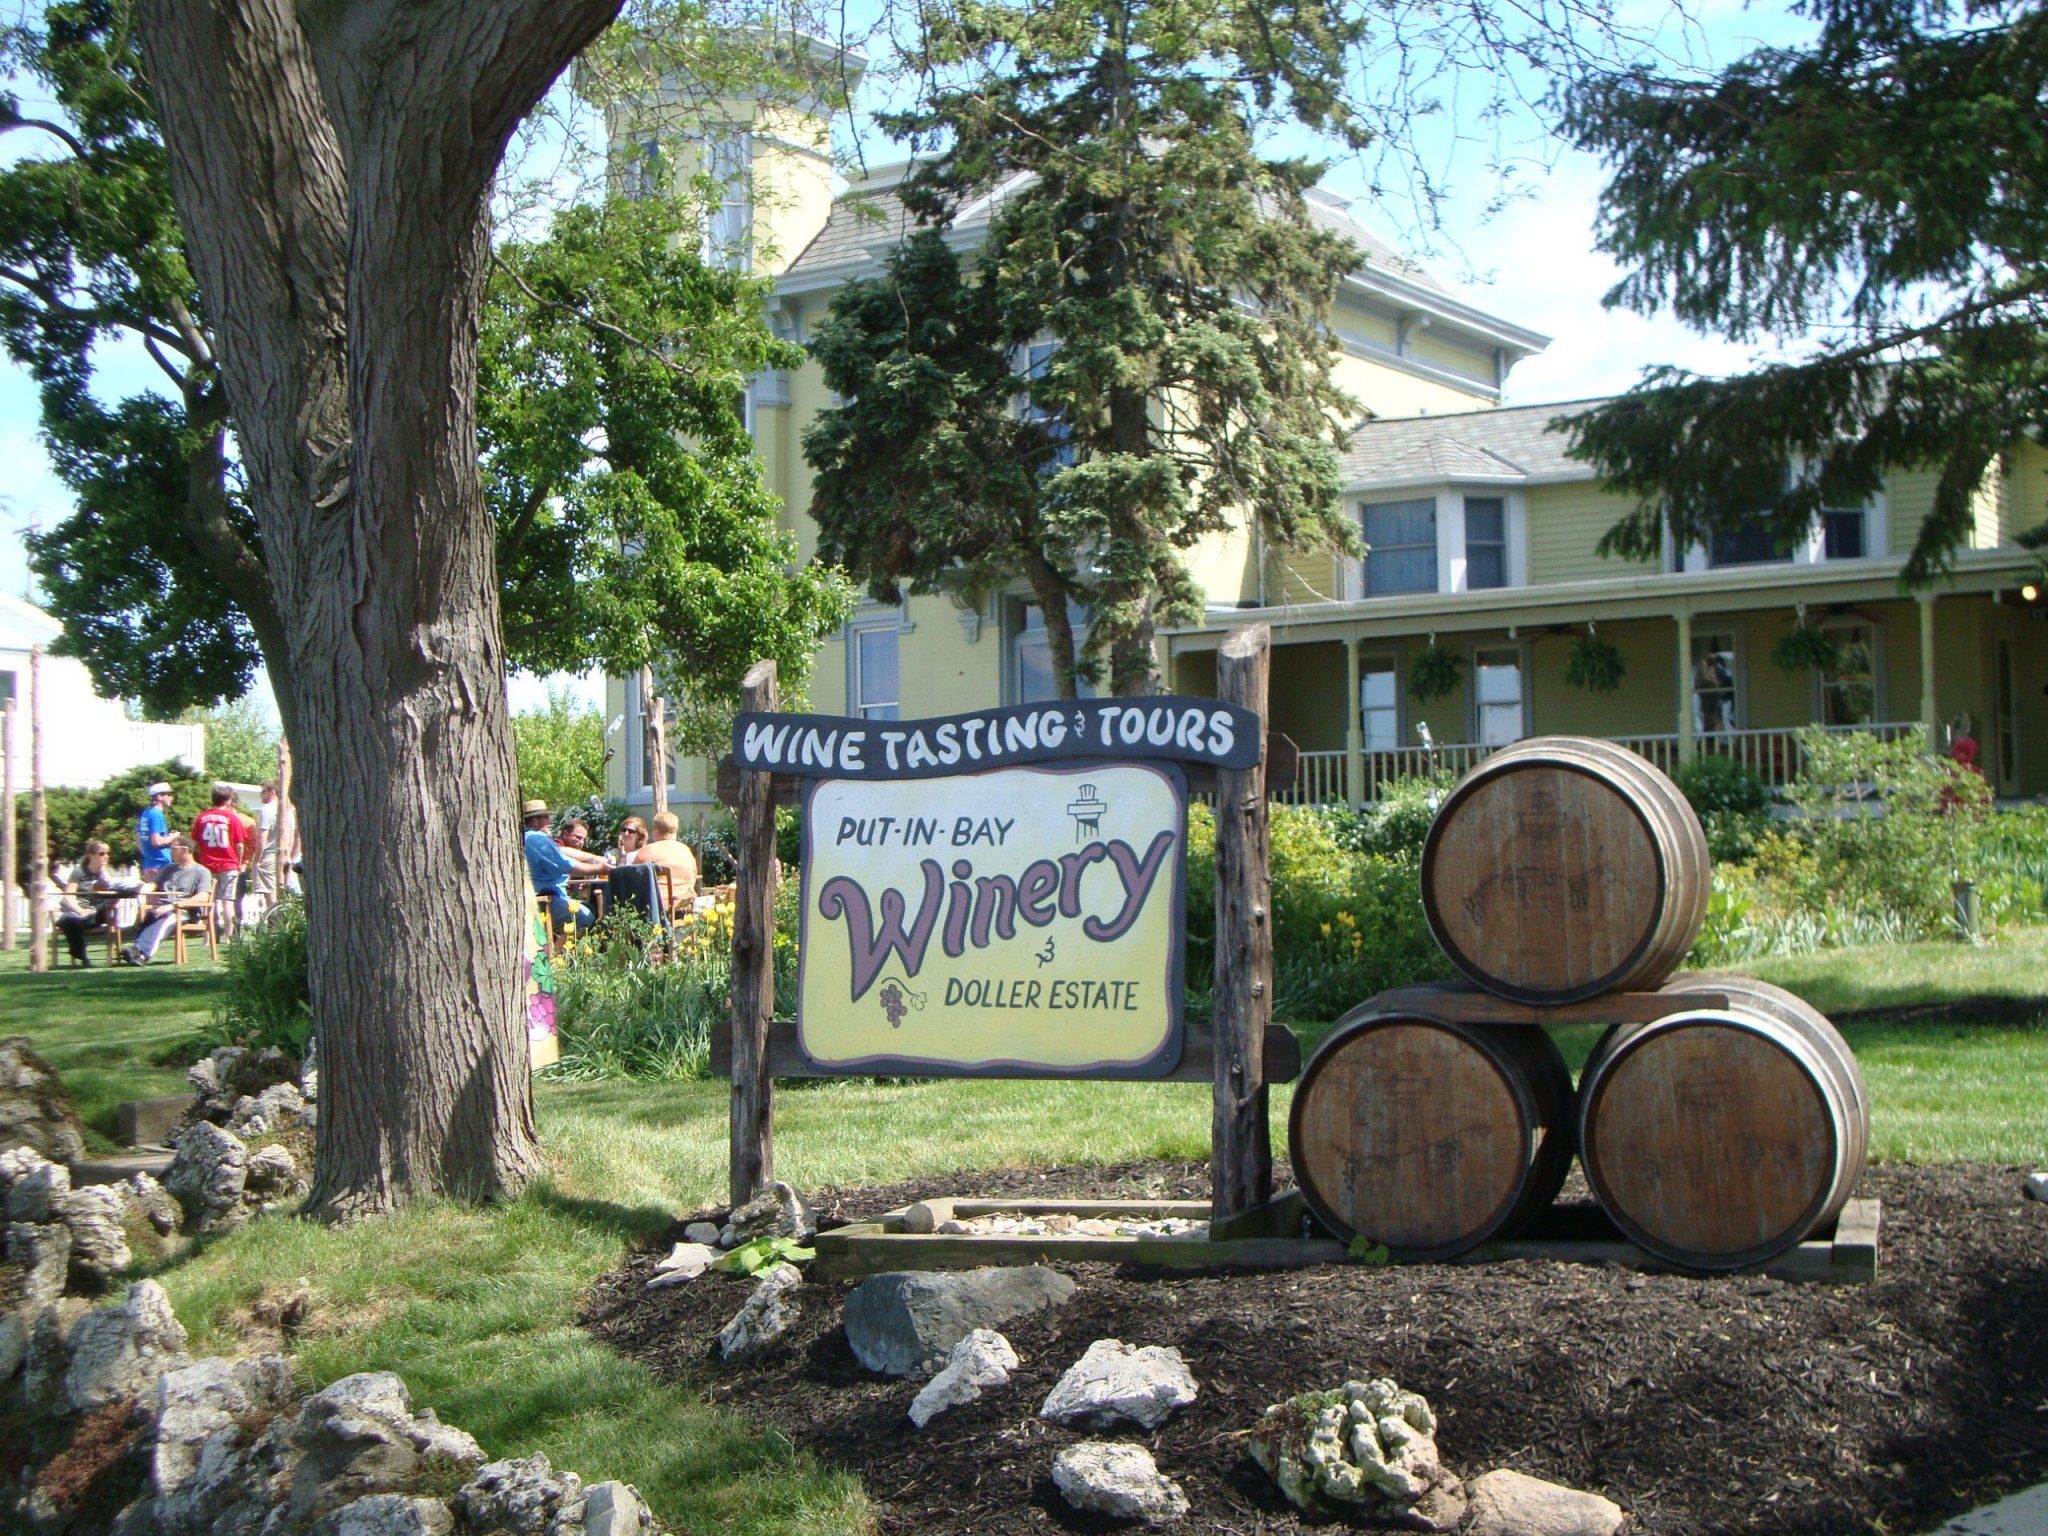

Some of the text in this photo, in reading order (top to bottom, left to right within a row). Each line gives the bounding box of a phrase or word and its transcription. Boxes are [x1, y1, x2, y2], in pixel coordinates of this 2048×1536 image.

[743, 721, 866, 770] WINE
[880, 710, 1068, 770] TASTING
[1098, 706, 1235, 756] TOURS
[202, 822, 229, 848] 40
[818, 830, 1176, 1003] Winery
[944, 976, 1141, 1011] DOLLER ESTATE
